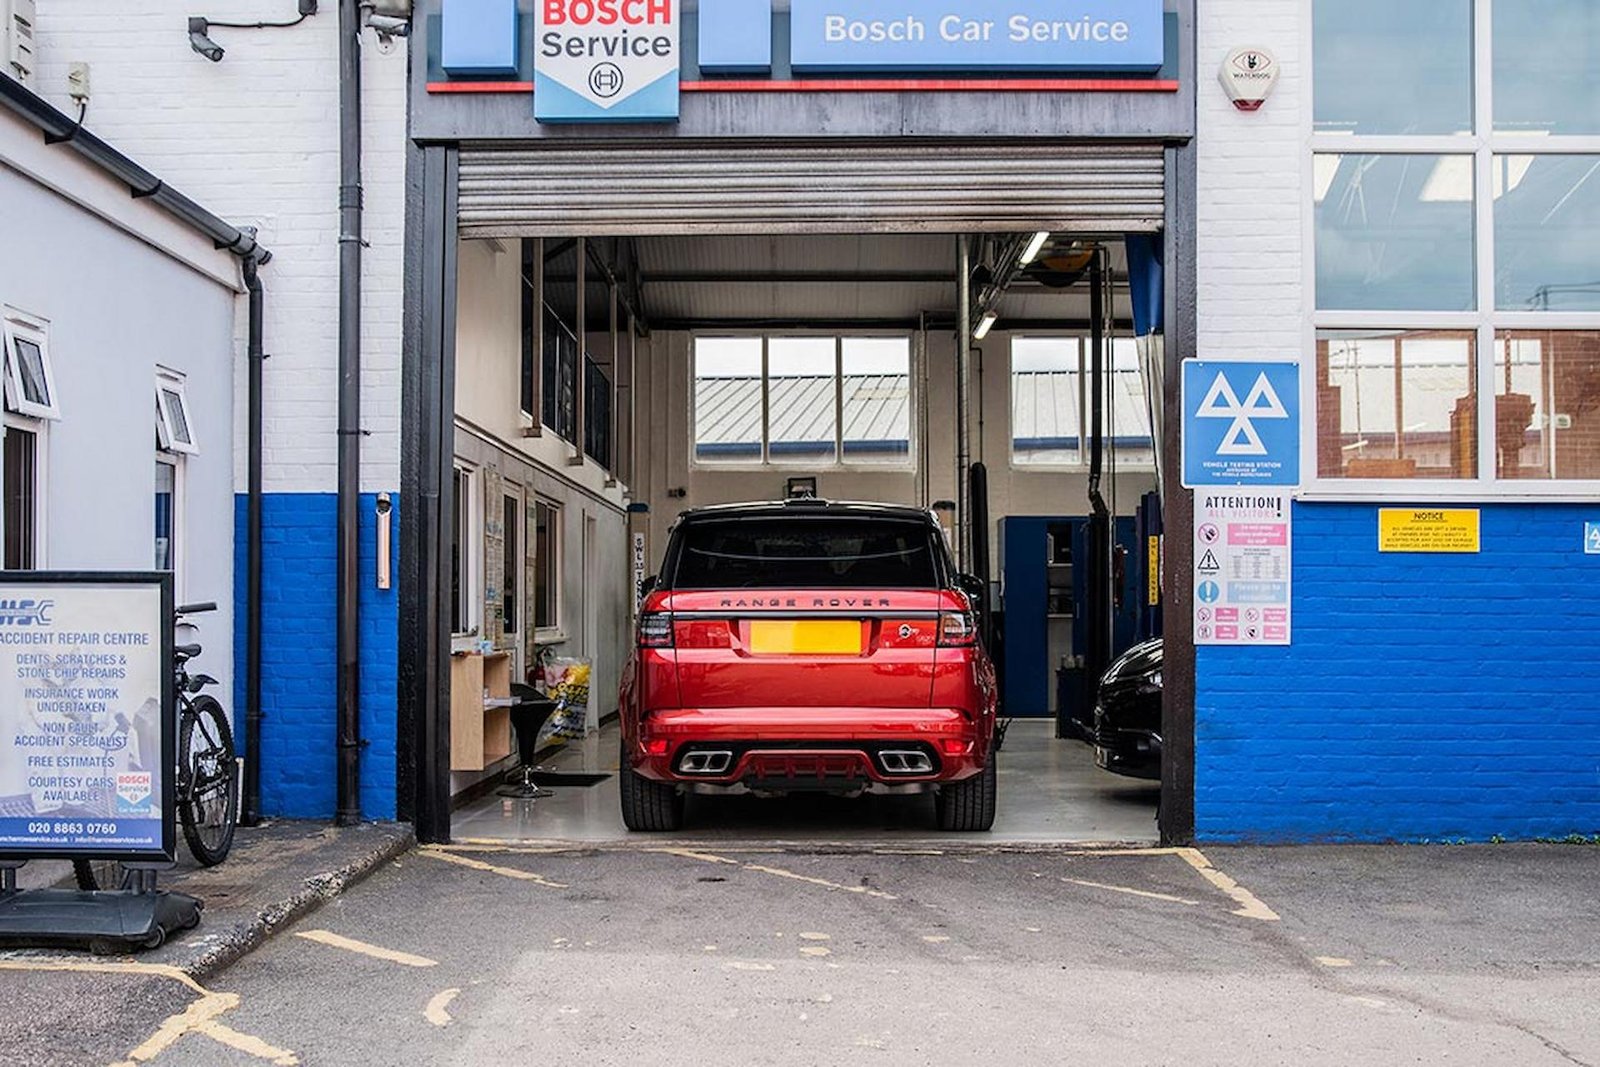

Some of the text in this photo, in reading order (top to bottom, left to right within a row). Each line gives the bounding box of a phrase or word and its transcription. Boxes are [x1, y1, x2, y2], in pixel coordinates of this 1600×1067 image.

[543, 0, 671, 25] BOSCH
[824, 15, 1129, 42] Bosch Car Service
[541, 28, 671, 57] Service
[1414, 512, 1444, 520] NOTICE
[58, 633, 100, 645] REPAIR
[103, 633, 149, 645] CENTRE
[55, 654, 117, 665] SCRATCHES
[119, 654, 127, 665] &
[18, 667, 126, 678] STONE CHIP REPAIRS
[25, 688, 119, 699] INSURANCE WORK
[37, 702, 106, 712] UNDERTAKEN
[43, 722, 99, 733] NON FAULT
[15, 736, 128, 747] ACCIDENT SPECIALIST
[28, 756, 115, 767] FREE ESTIMATES
[28, 777, 115, 788] COURTESY CARS
[118, 776, 149, 784] BOSCH
[43, 790, 101, 801] AVAILABLE
[28, 822, 117, 835] 020 8863 0760
